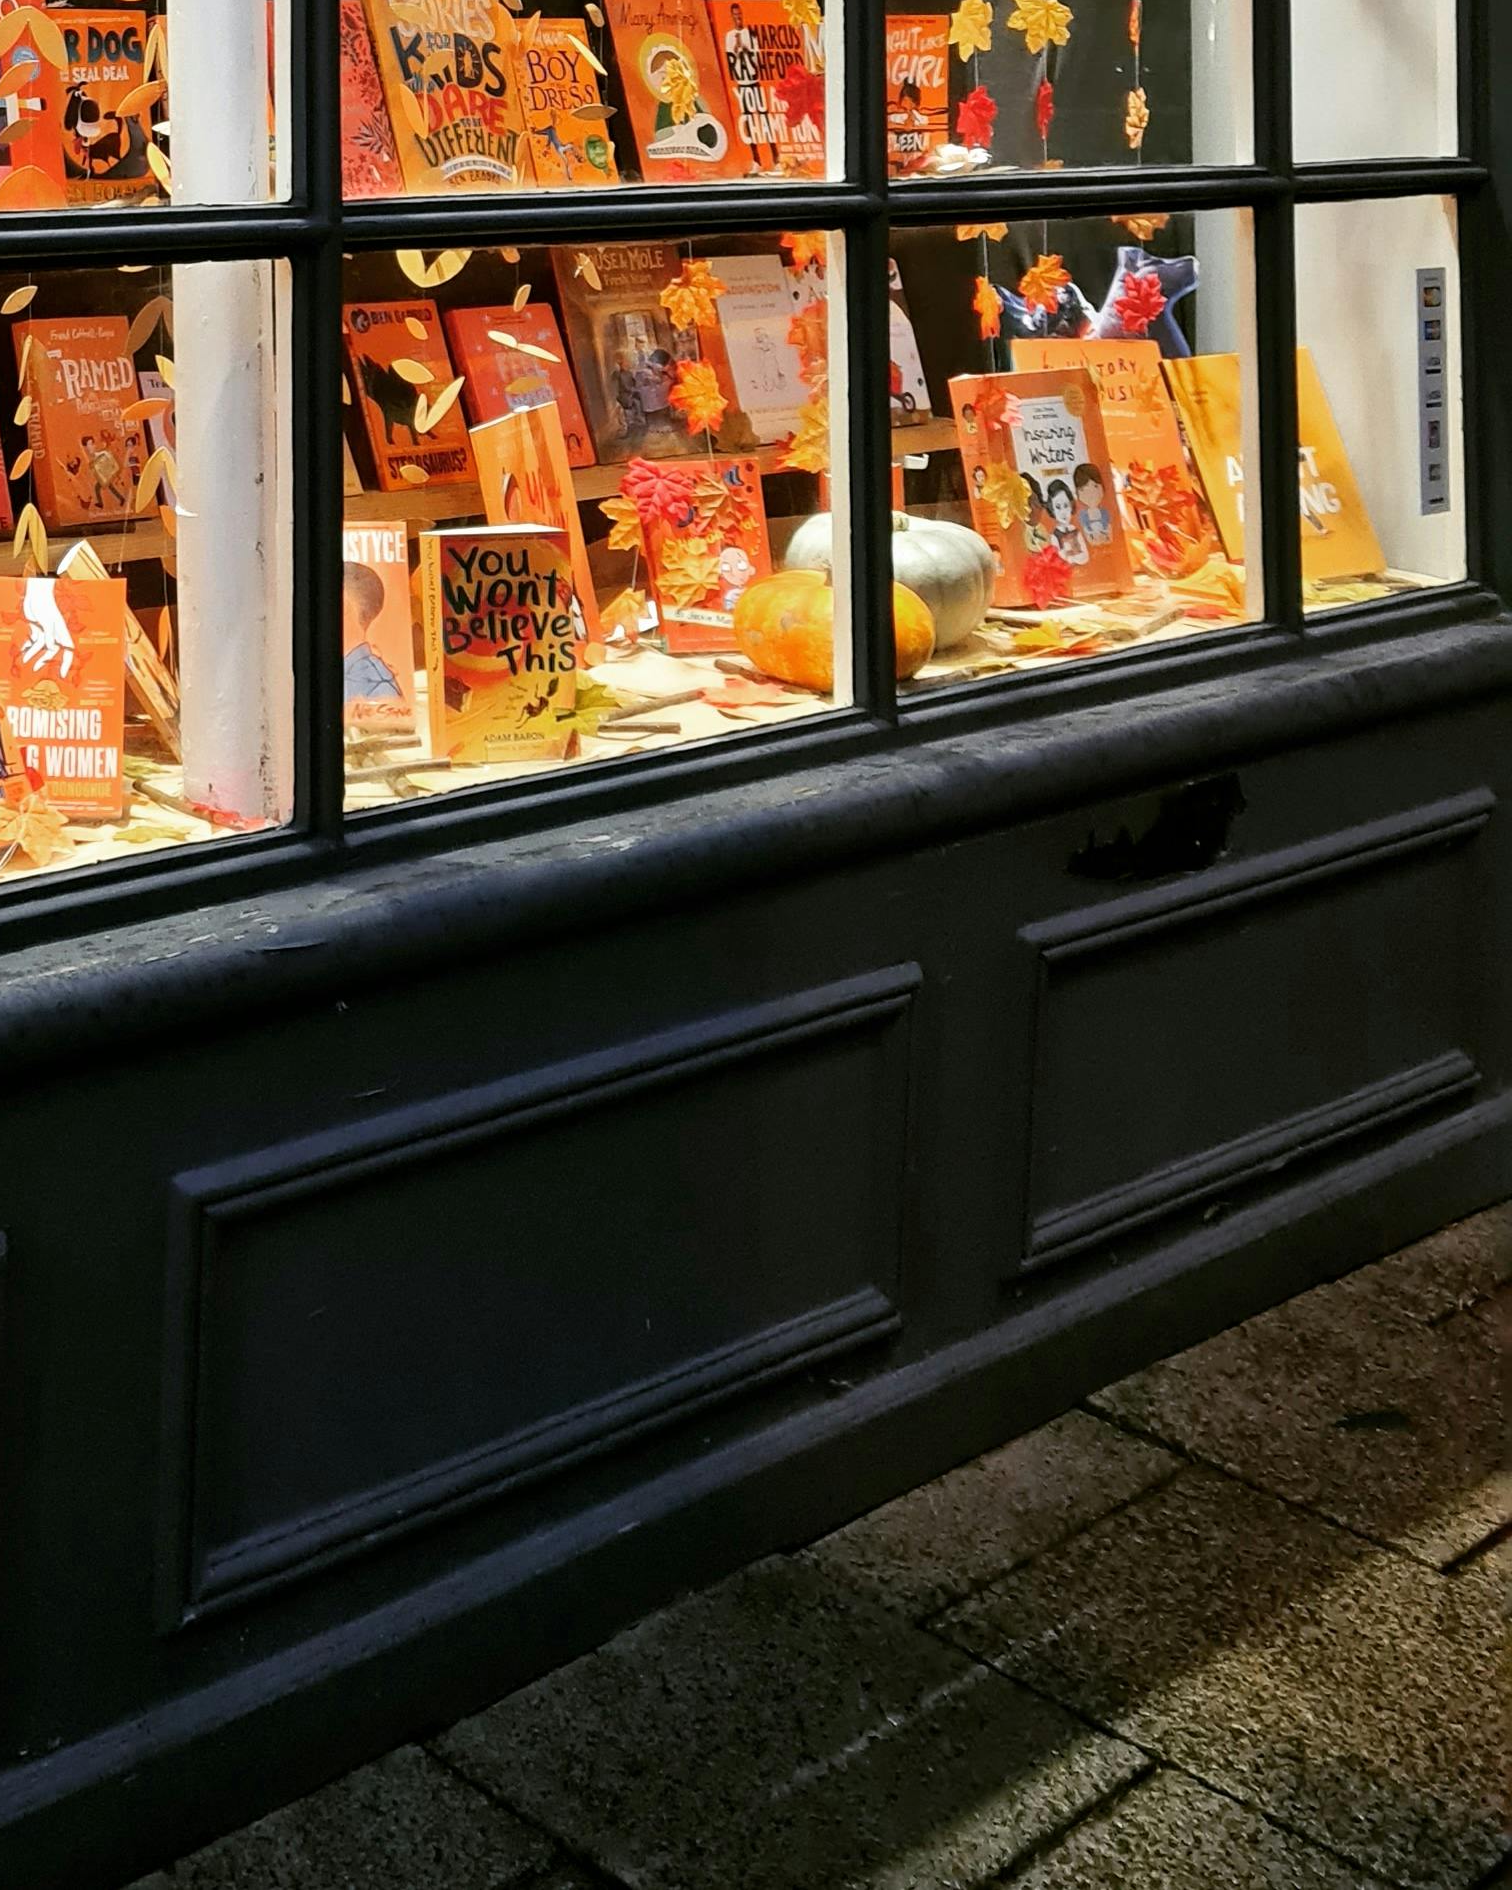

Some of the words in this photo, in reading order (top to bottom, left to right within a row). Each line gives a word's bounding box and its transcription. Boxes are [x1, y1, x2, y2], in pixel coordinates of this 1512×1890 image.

[64, 28, 80, 63] R
[87, 26, 144, 63] DOG
[747, 23, 801, 50] MARCUS
[72, 67, 101, 83] SEAL
[102, 63, 129, 82] DEAL
[526, 49, 581, 85] BOY
[890, 55, 946, 88] GIRL
[415, 84, 508, 136] DARE
[528, 84, 595, 111] DRESS
[732, 85, 768, 113] YOU
[415, 124, 520, 168] DIFFERENT
[1029, 446, 1075, 464] Writers
[6, 705, 102, 741] ROMISING
[352, 703, 372, 719] Nic
[375, 702, 412, 718] Stone
[483, 732, 512, 743] ADAM
[513, 732, 545, 742] BARON
[44, 746, 118, 779] WOMEN
